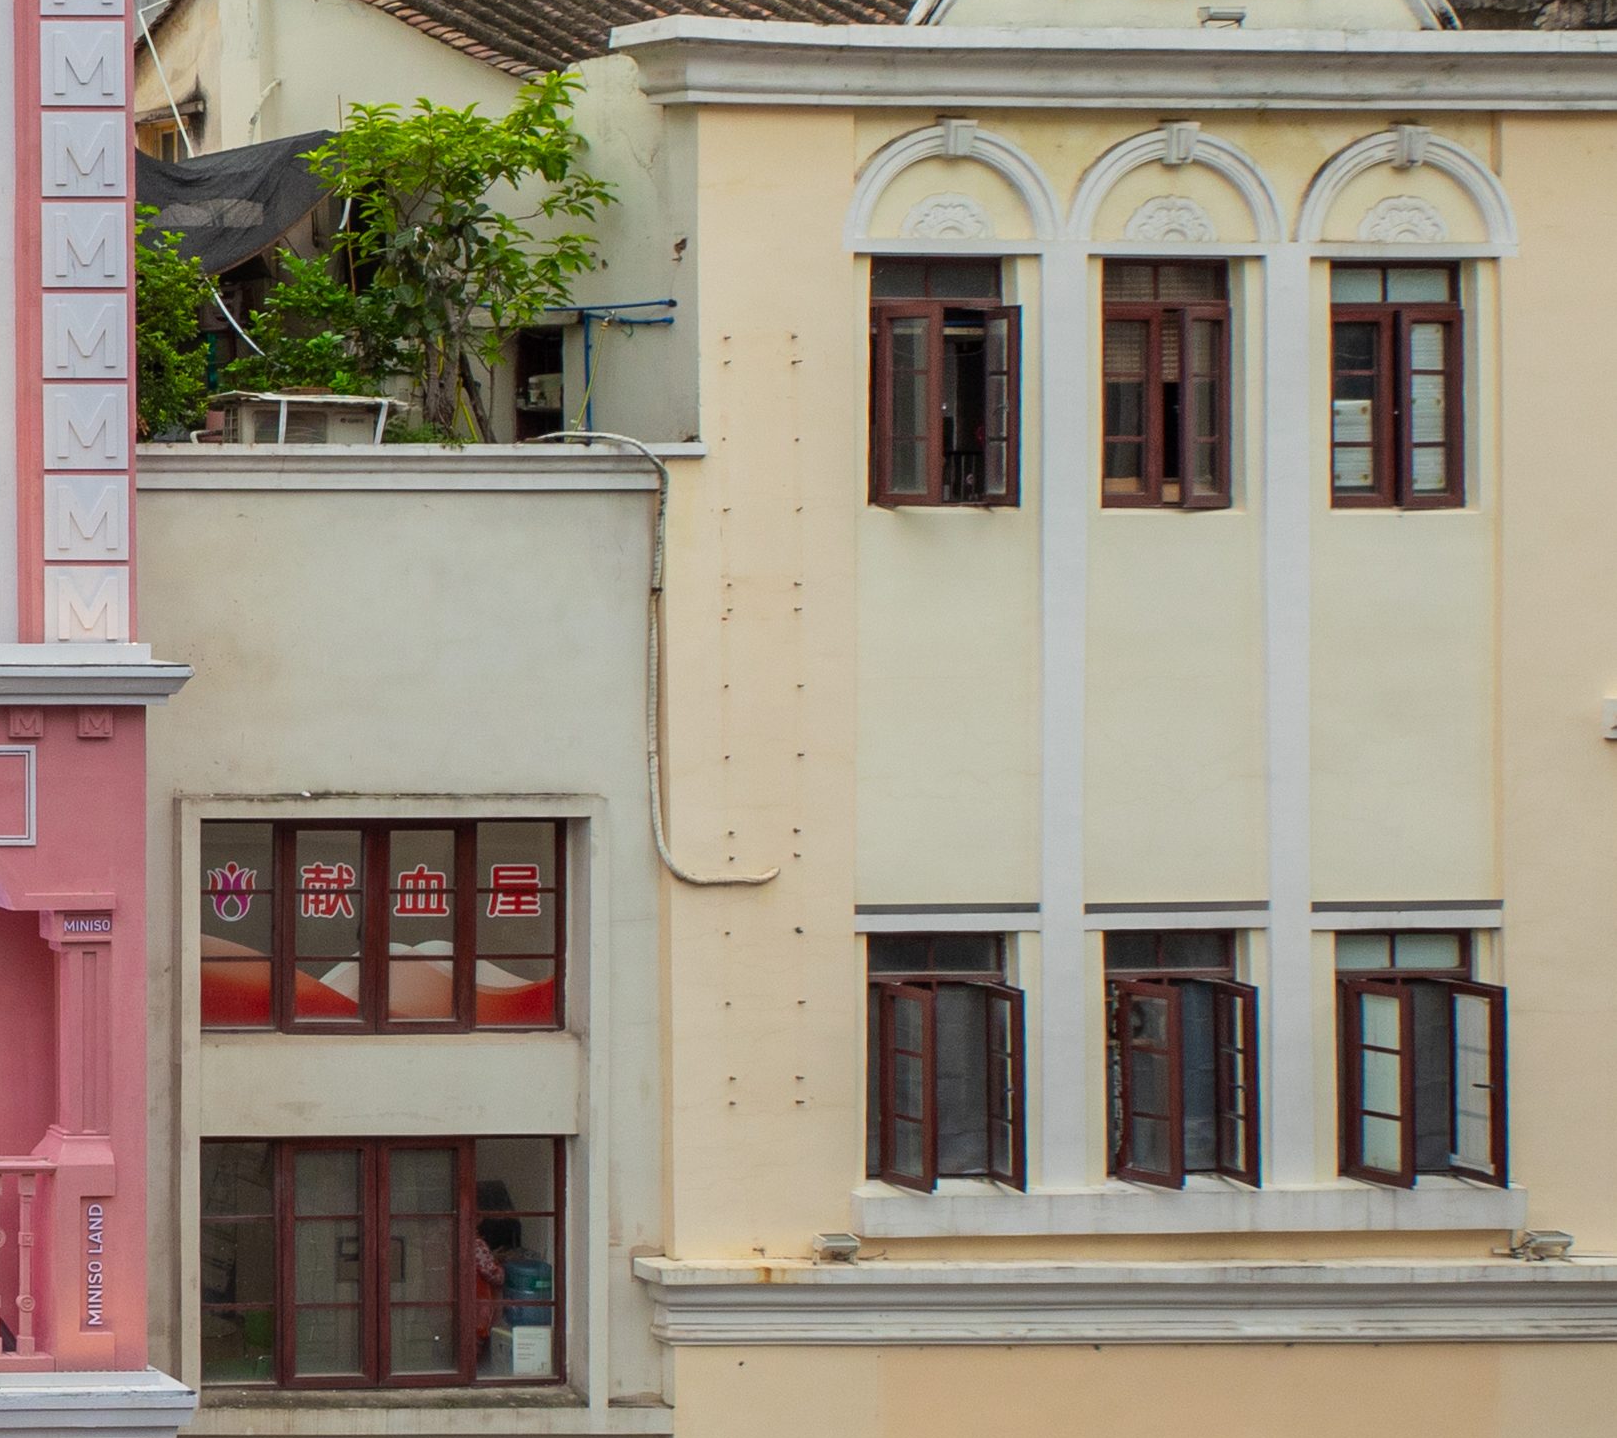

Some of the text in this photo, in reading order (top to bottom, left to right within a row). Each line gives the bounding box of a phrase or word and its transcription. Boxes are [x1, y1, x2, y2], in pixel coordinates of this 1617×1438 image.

[300, 861, 541, 918] 献血屋
[64, 918, 111, 932] MINISO
